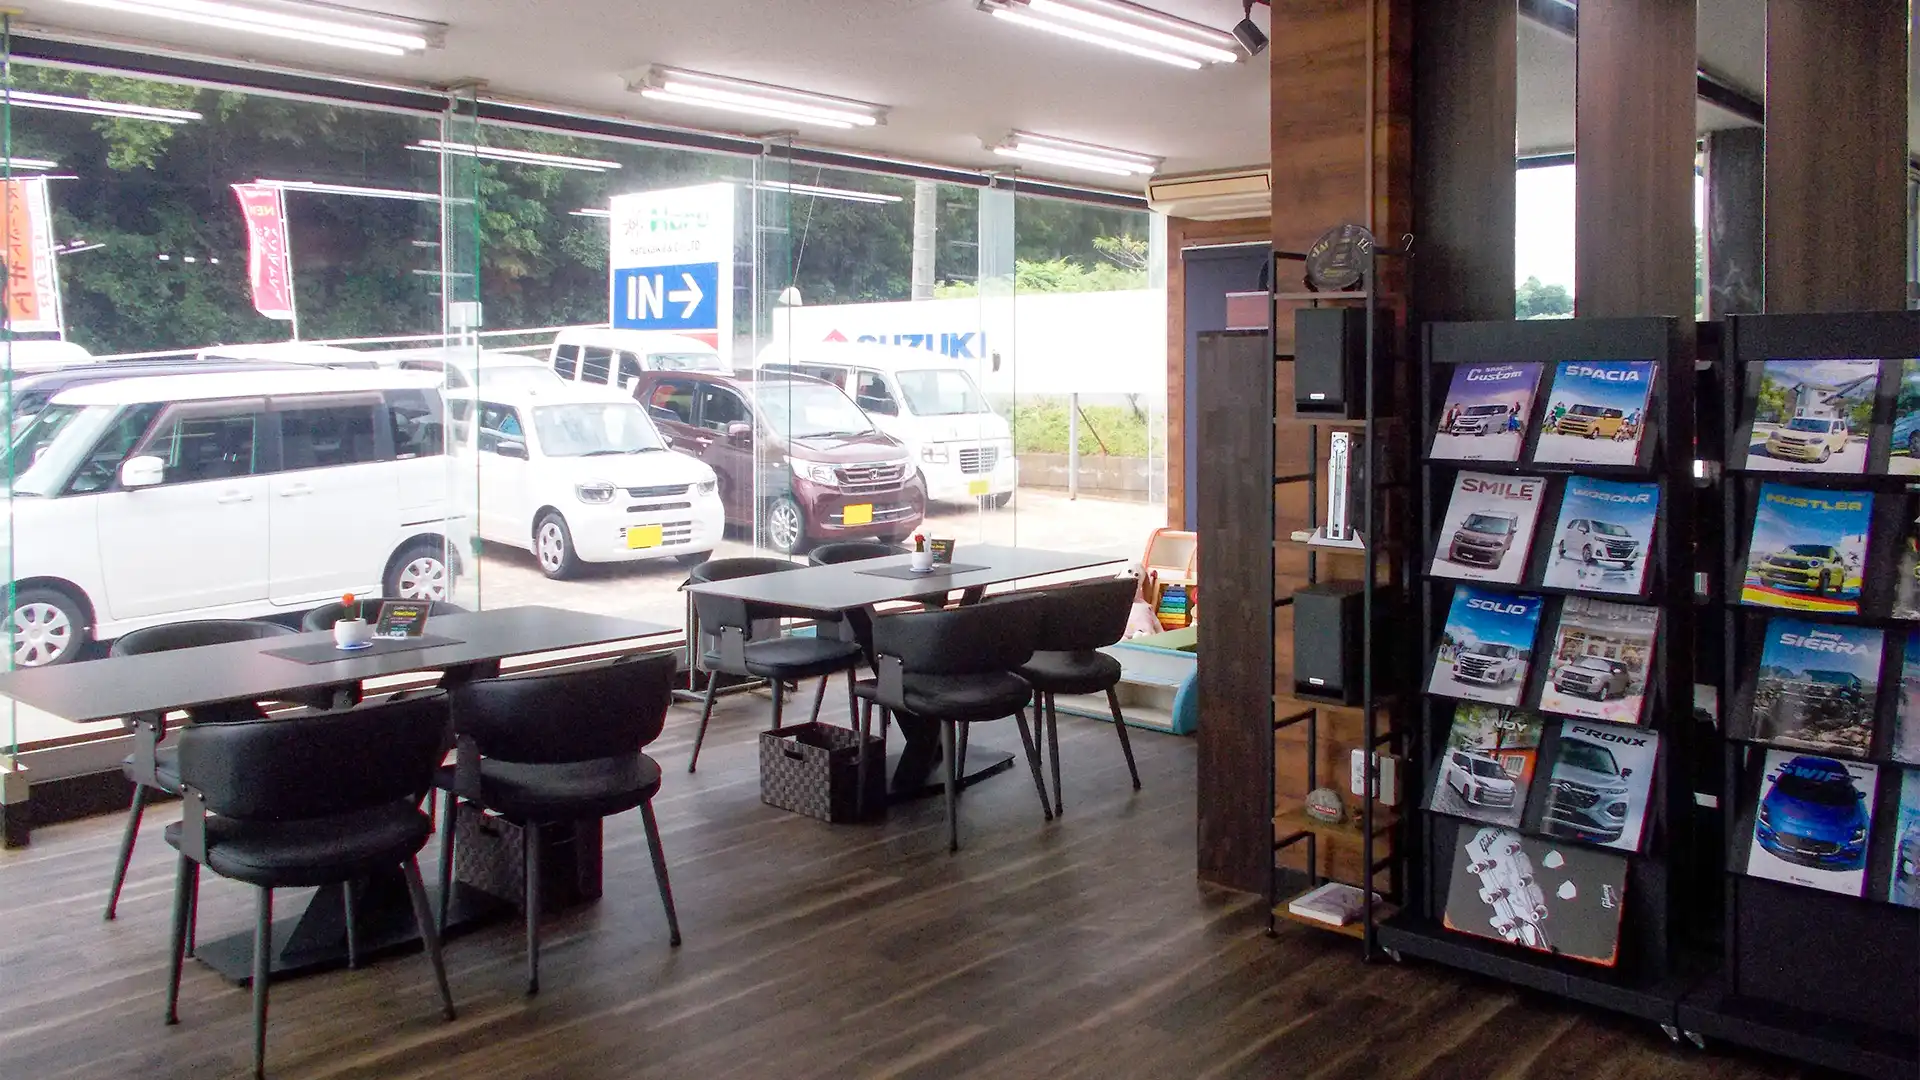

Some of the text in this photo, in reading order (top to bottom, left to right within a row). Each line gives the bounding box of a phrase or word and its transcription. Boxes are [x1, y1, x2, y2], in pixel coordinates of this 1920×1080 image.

[627, 274, 664, 320] IN
[1467, 369, 1523, 381] Custom
[1565, 365, 1640, 382] SPACIA
[1461, 478, 1534, 499] SMILE
[1766, 493, 1863, 512] HUSTLER
[1466, 598, 1528, 615] SOLIO
[1780, 633, 1869, 655] SIERRA
[1572, 726, 1648, 748] FRONX
